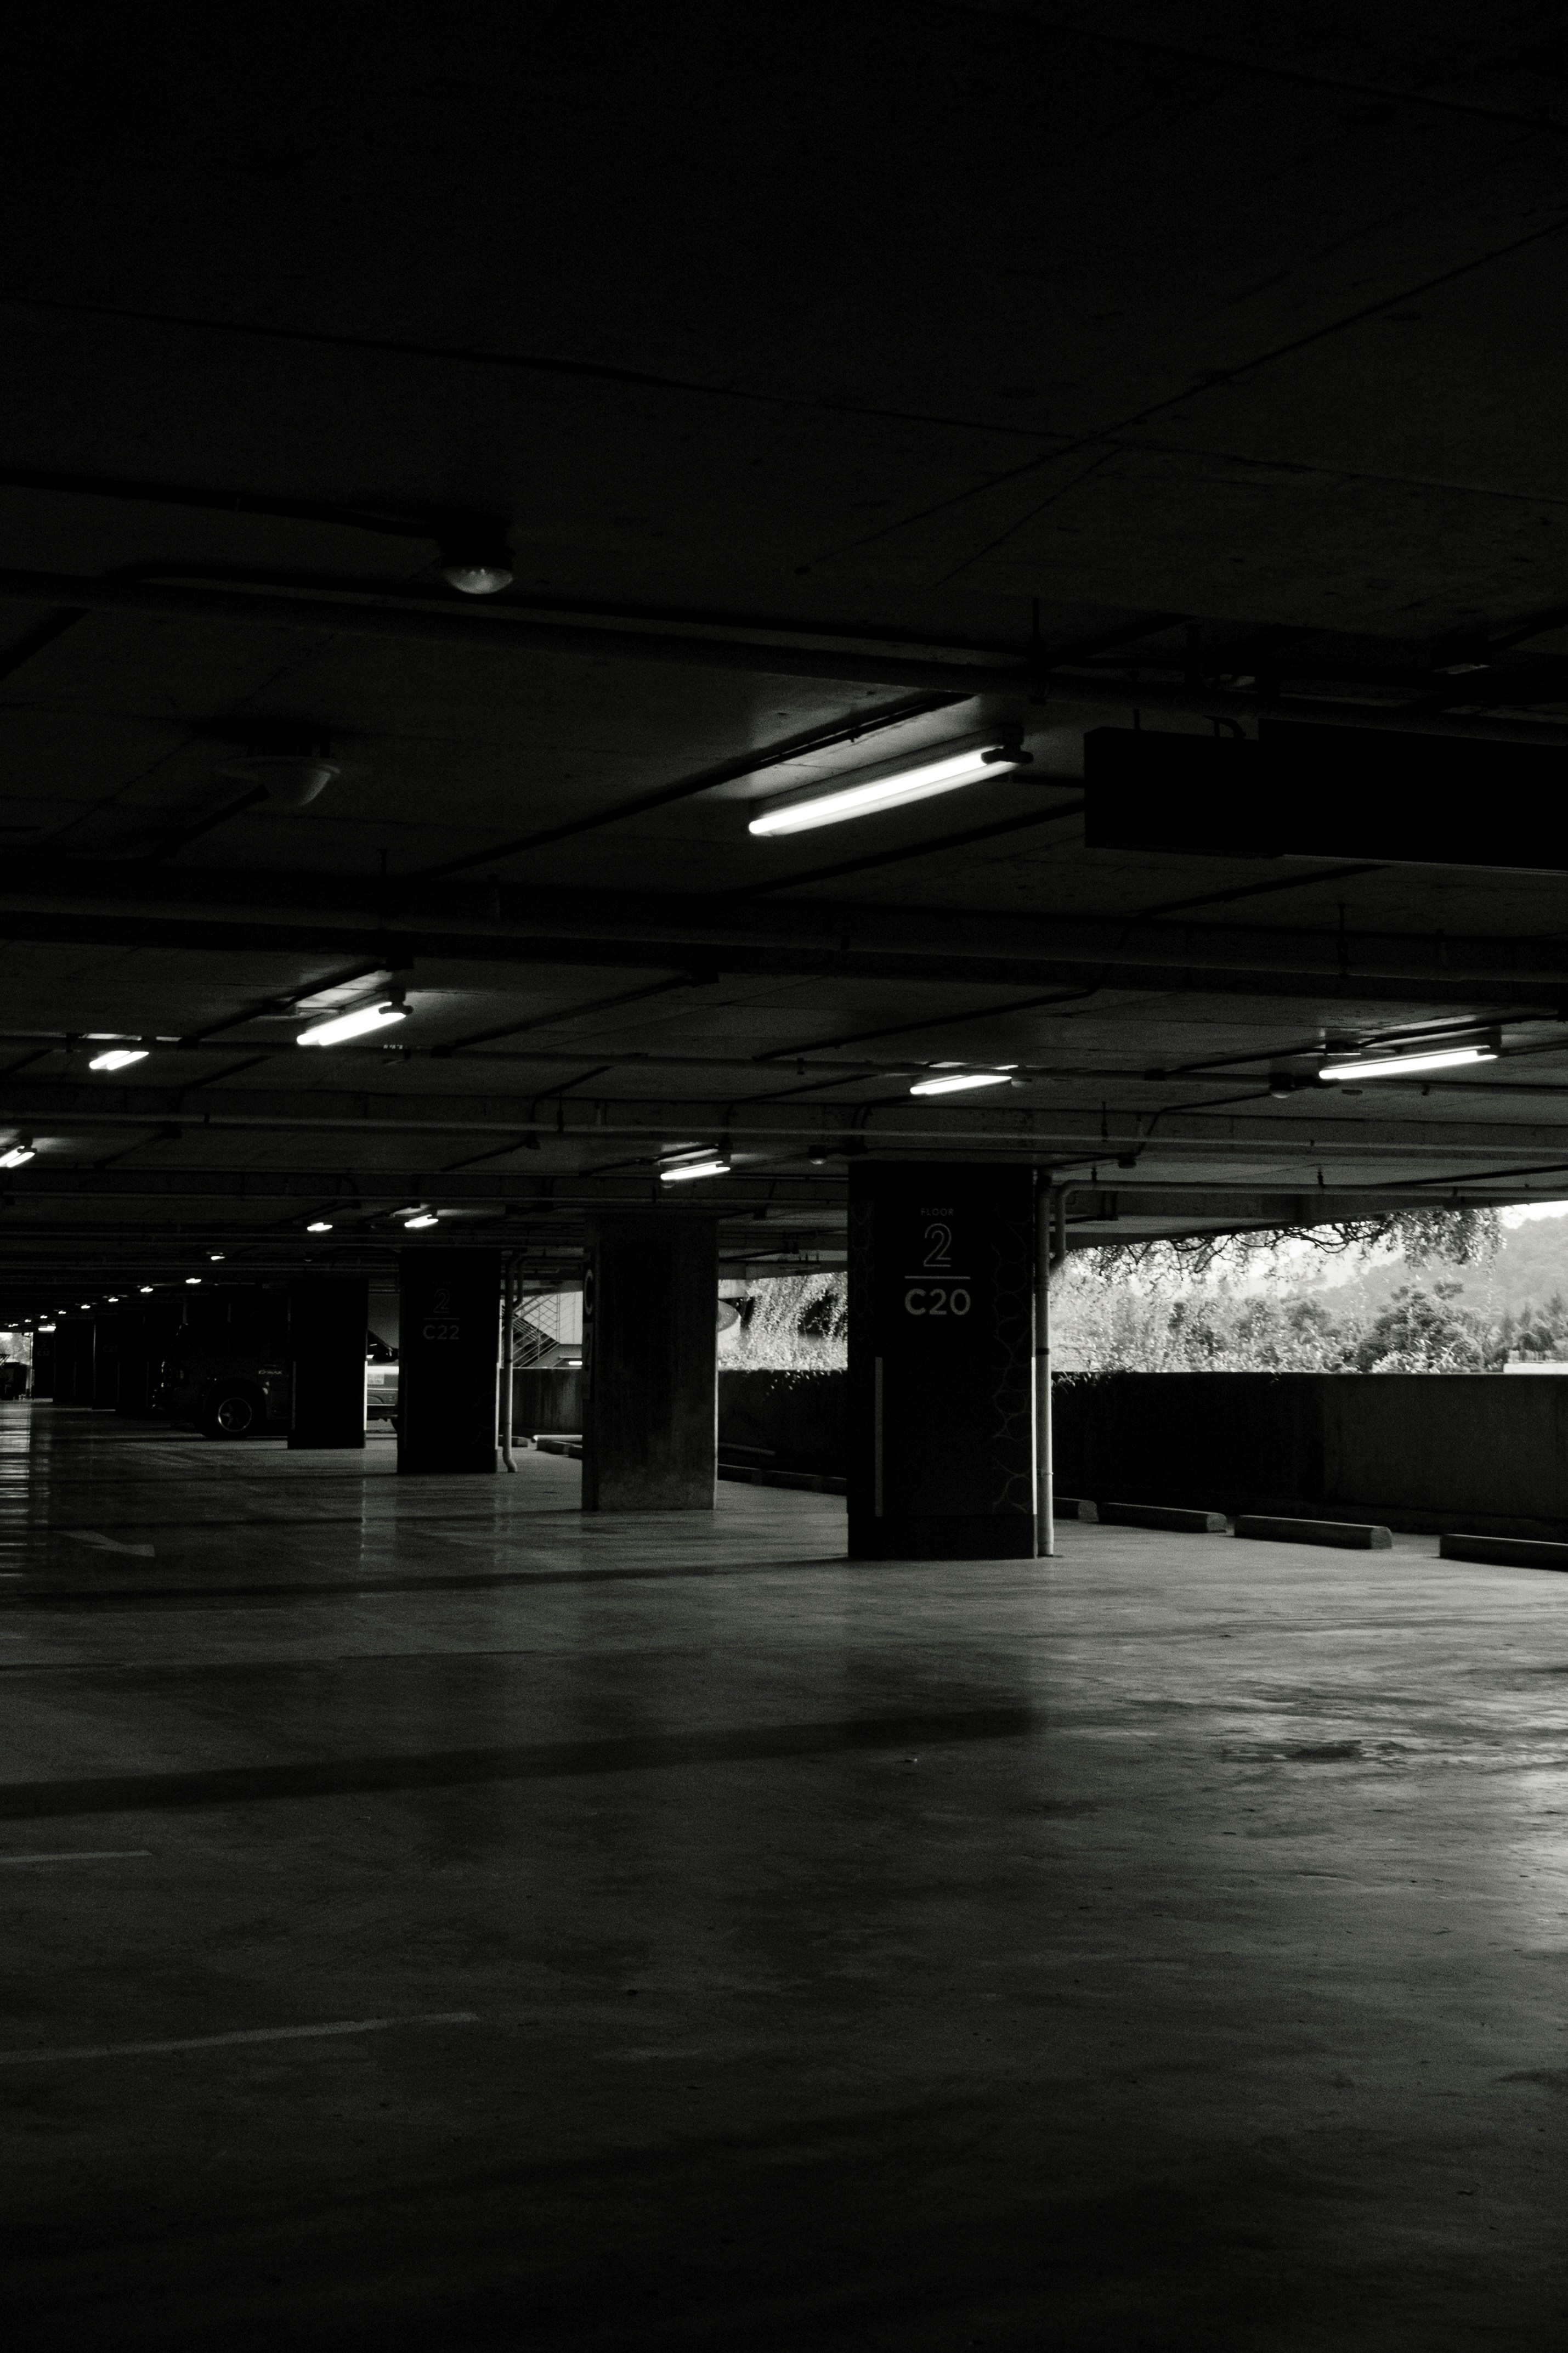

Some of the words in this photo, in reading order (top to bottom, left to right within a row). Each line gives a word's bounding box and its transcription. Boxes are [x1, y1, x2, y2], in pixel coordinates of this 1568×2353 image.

[920, 1207, 954, 1216] FLOOR
[922, 1222, 952, 1267] 2
[432, 1288, 451, 1313] 2
[584, 1269, 593, 1316] C
[904, 1288, 971, 1316] C20
[422, 1324, 460, 1340] C22
